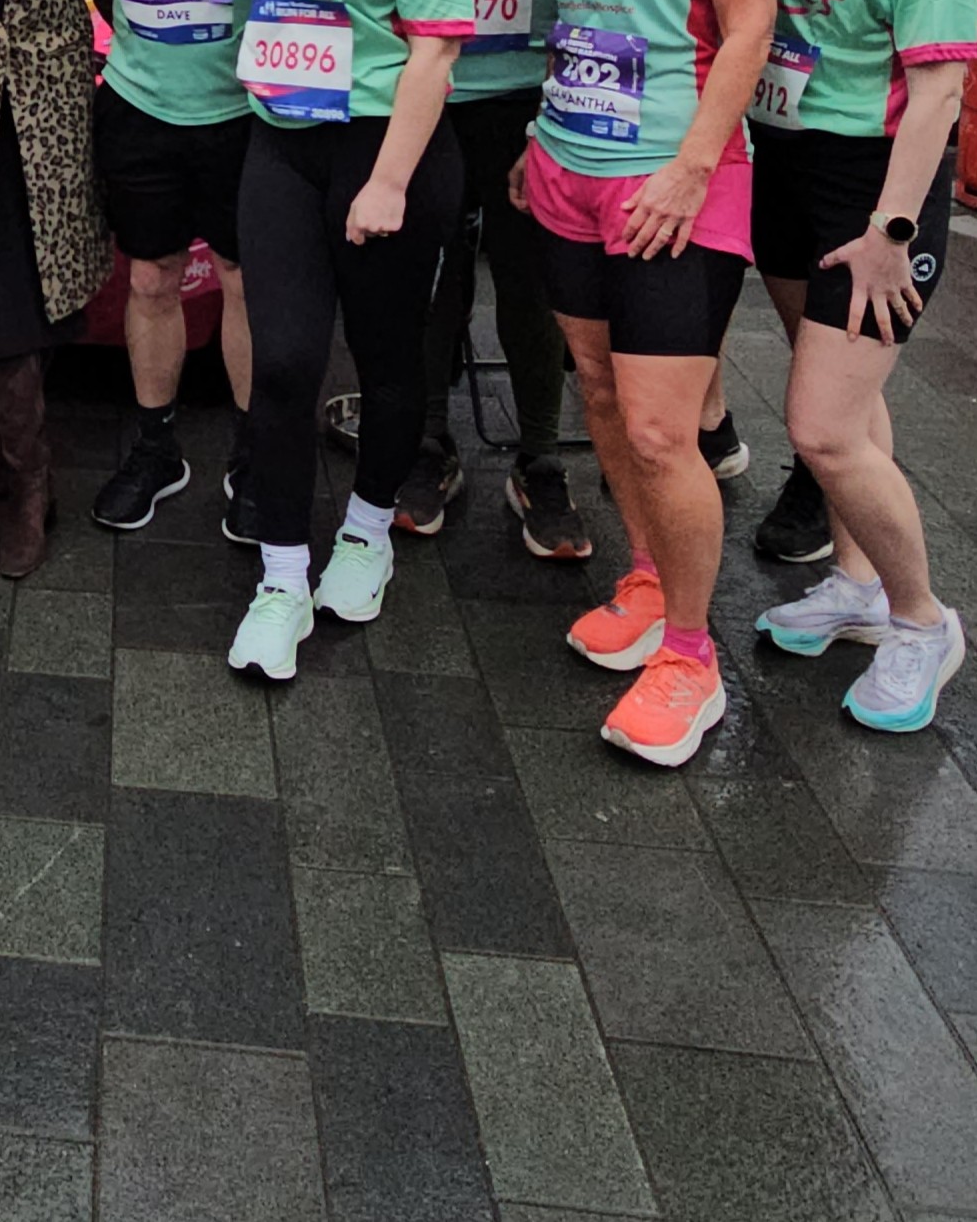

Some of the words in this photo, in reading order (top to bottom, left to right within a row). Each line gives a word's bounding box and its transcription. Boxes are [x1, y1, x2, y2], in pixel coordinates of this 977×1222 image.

[156, 9, 191, 21] DAVE
[254, 39, 337, 74] 30896
[754, 78, 789, 118] 912
